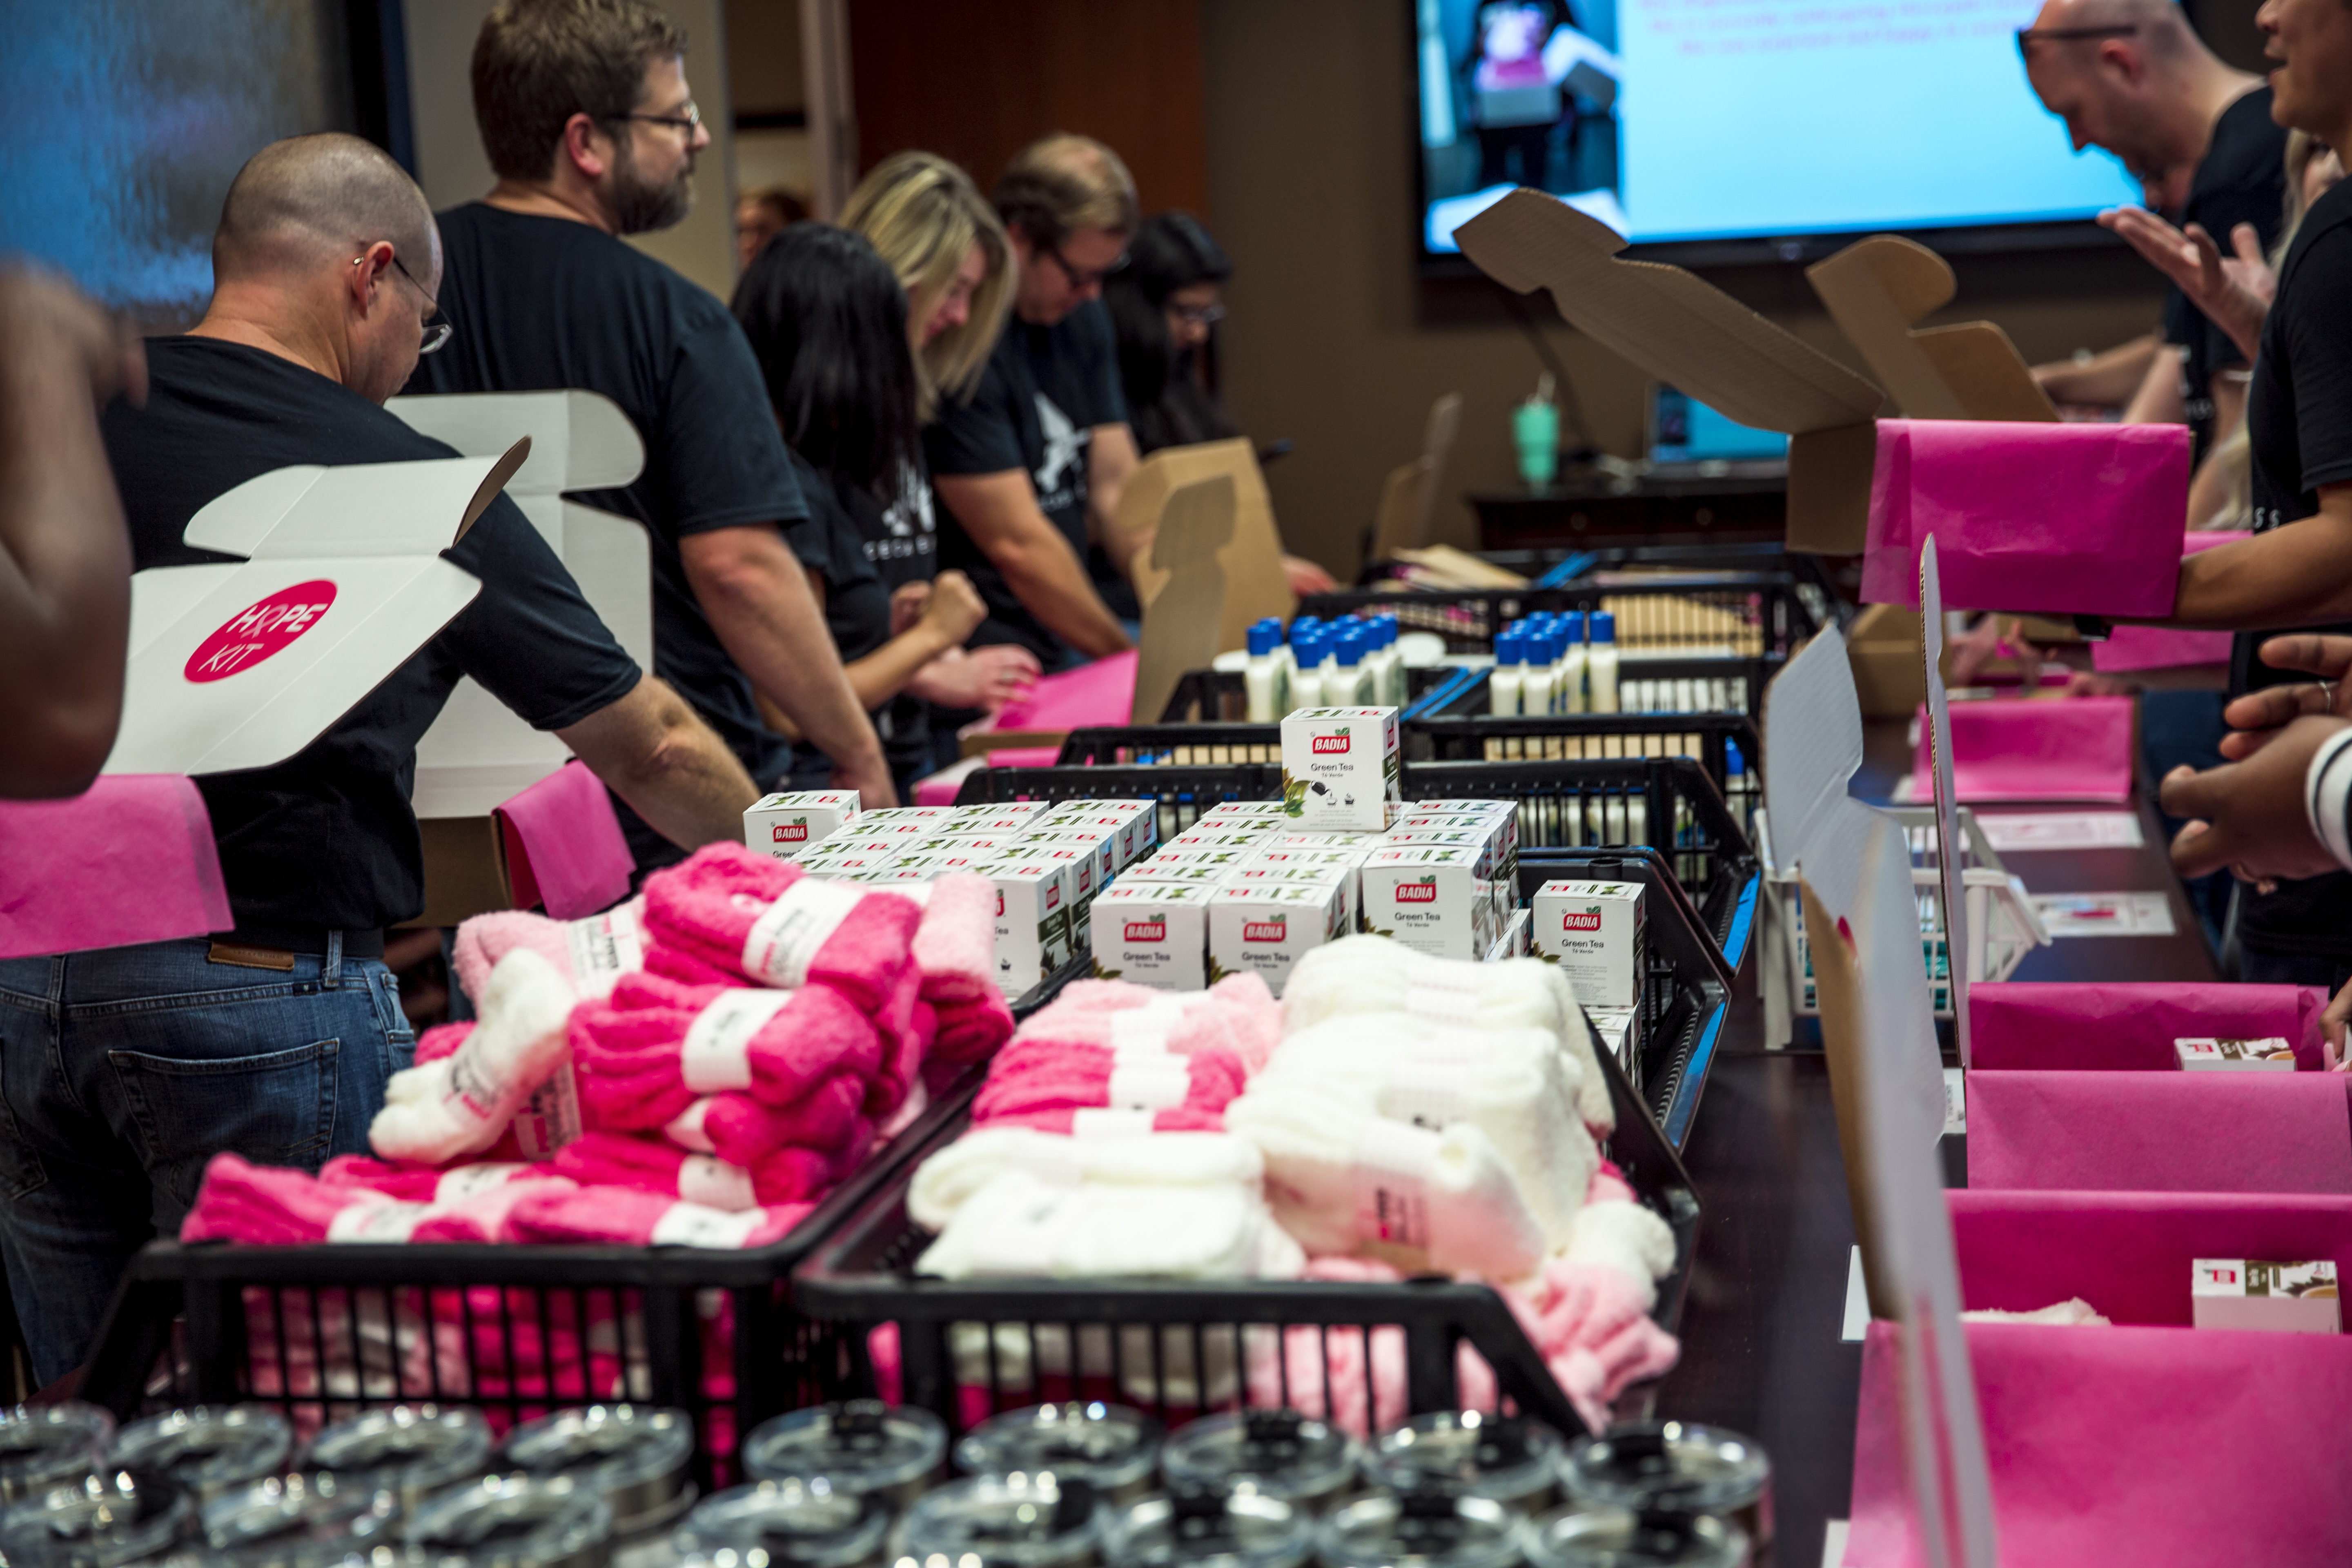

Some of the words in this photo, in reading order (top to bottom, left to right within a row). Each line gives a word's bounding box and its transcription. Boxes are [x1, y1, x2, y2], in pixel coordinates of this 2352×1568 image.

[226, 603, 329, 639] HOPE
[197, 643, 265, 673] KIT
[1314, 738, 1348, 751] BADIA
[1311, 763, 1337, 771] Green
[1338, 762, 1354, 771] Tea
[775, 827, 804, 840] BADIA
[1398, 886, 1433, 899] BADIA
[1394, 911, 1423, 921] Green
[1424, 912, 1441, 921] Tea
[1565, 915, 1598, 928] BADIA
[1127, 925, 1163, 939] BADIA
[1246, 925, 1283, 939] BADIA
[1561, 939, 1588, 947] Green
[1588, 940, 1604, 948] Tea
[1123, 951, 1153, 961] Green
[1154, 952, 1171, 961] Tea
[1241, 951, 1272, 961] Green
[1274, 952, 1290, 962] Tea
